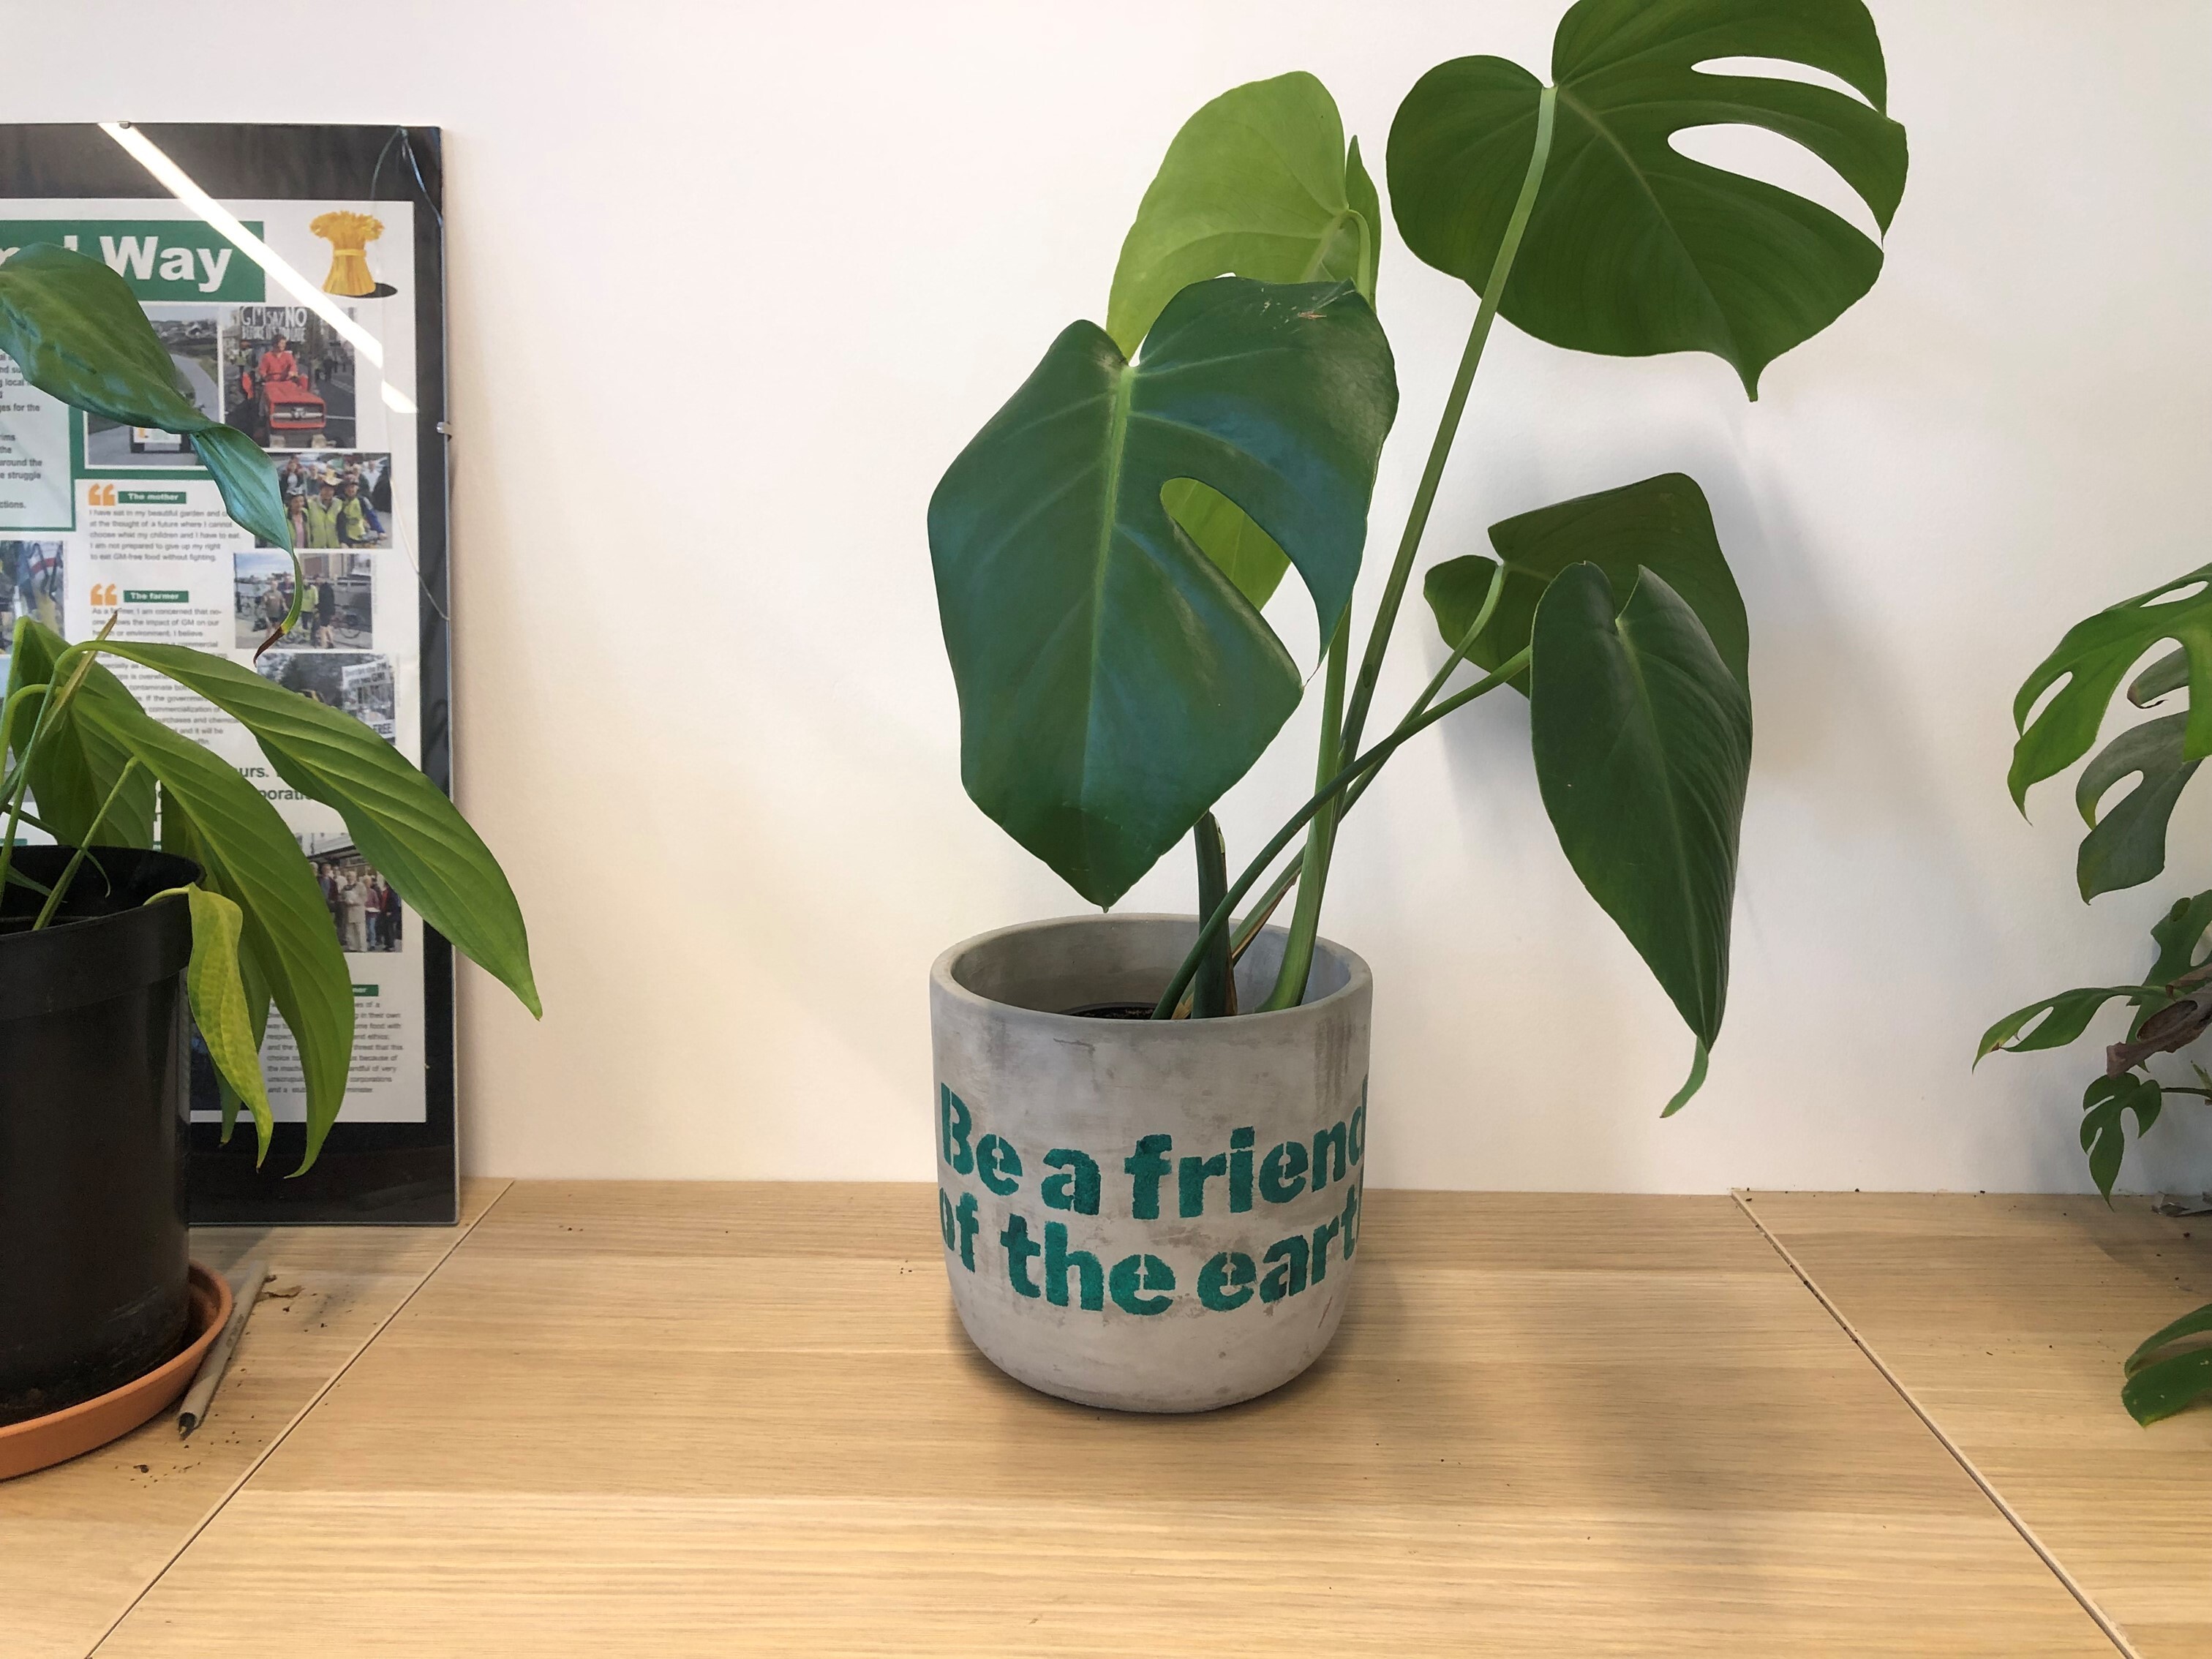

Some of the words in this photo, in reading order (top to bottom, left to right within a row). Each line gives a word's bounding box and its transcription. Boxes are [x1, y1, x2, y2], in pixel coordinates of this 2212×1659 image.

[99, 236, 233, 293] Way
[285, 306, 307, 328] NO
[13, 403, 25, 411] for
[7, 472, 41, 481] struggle
[128, 492, 144, 500] The
[135, 511, 146, 519] my
[131, 592, 147, 600] The
[149, 592, 178, 600] farmer
[941, 1083, 1023, 1196] Be
[1041, 1148, 1101, 1216] a
[1124, 1074, 1368, 1220] friend
[939, 1187, 979, 1273] of
[1000, 1214, 1176, 1316] the
[1197, 1162, 1363, 1312] eart
